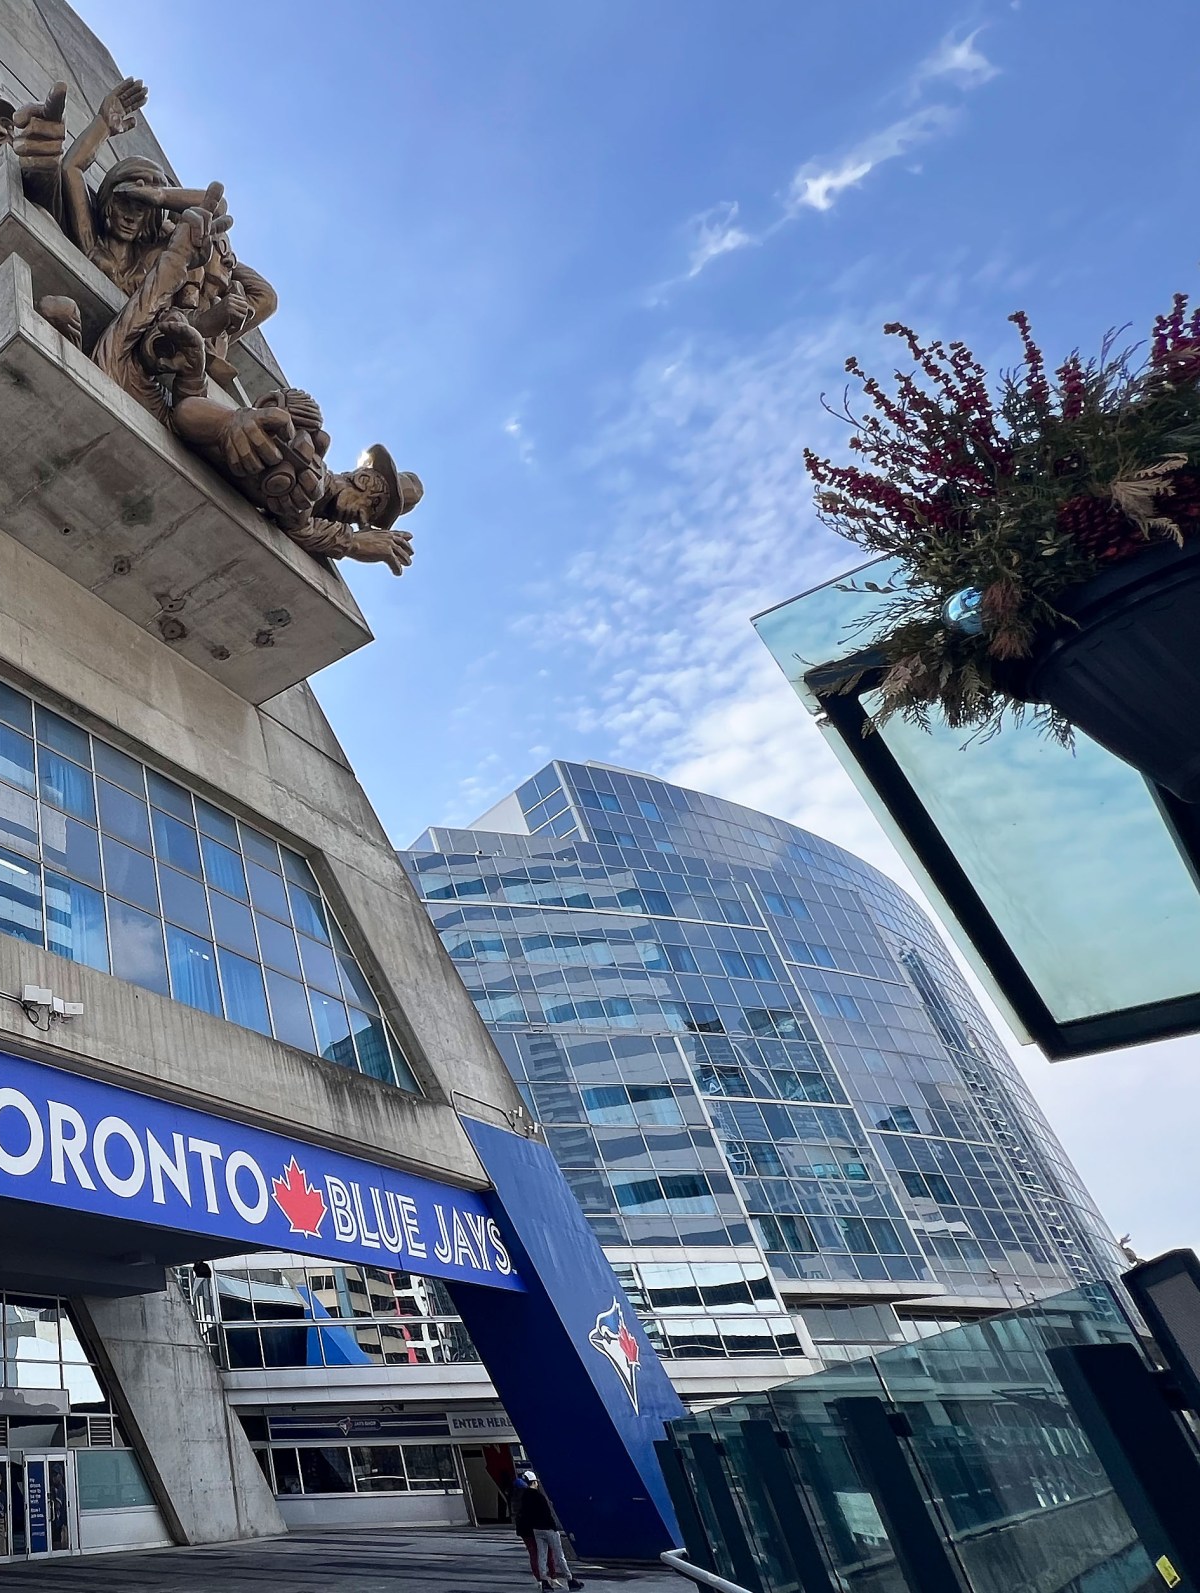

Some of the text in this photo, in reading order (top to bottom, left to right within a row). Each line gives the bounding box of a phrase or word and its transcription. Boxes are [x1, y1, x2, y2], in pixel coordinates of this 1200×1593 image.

[323, 1174, 428, 1259] BLUE
[433, 1204, 512, 1276] JAYS
[452, 1417, 484, 1429] ENTER
